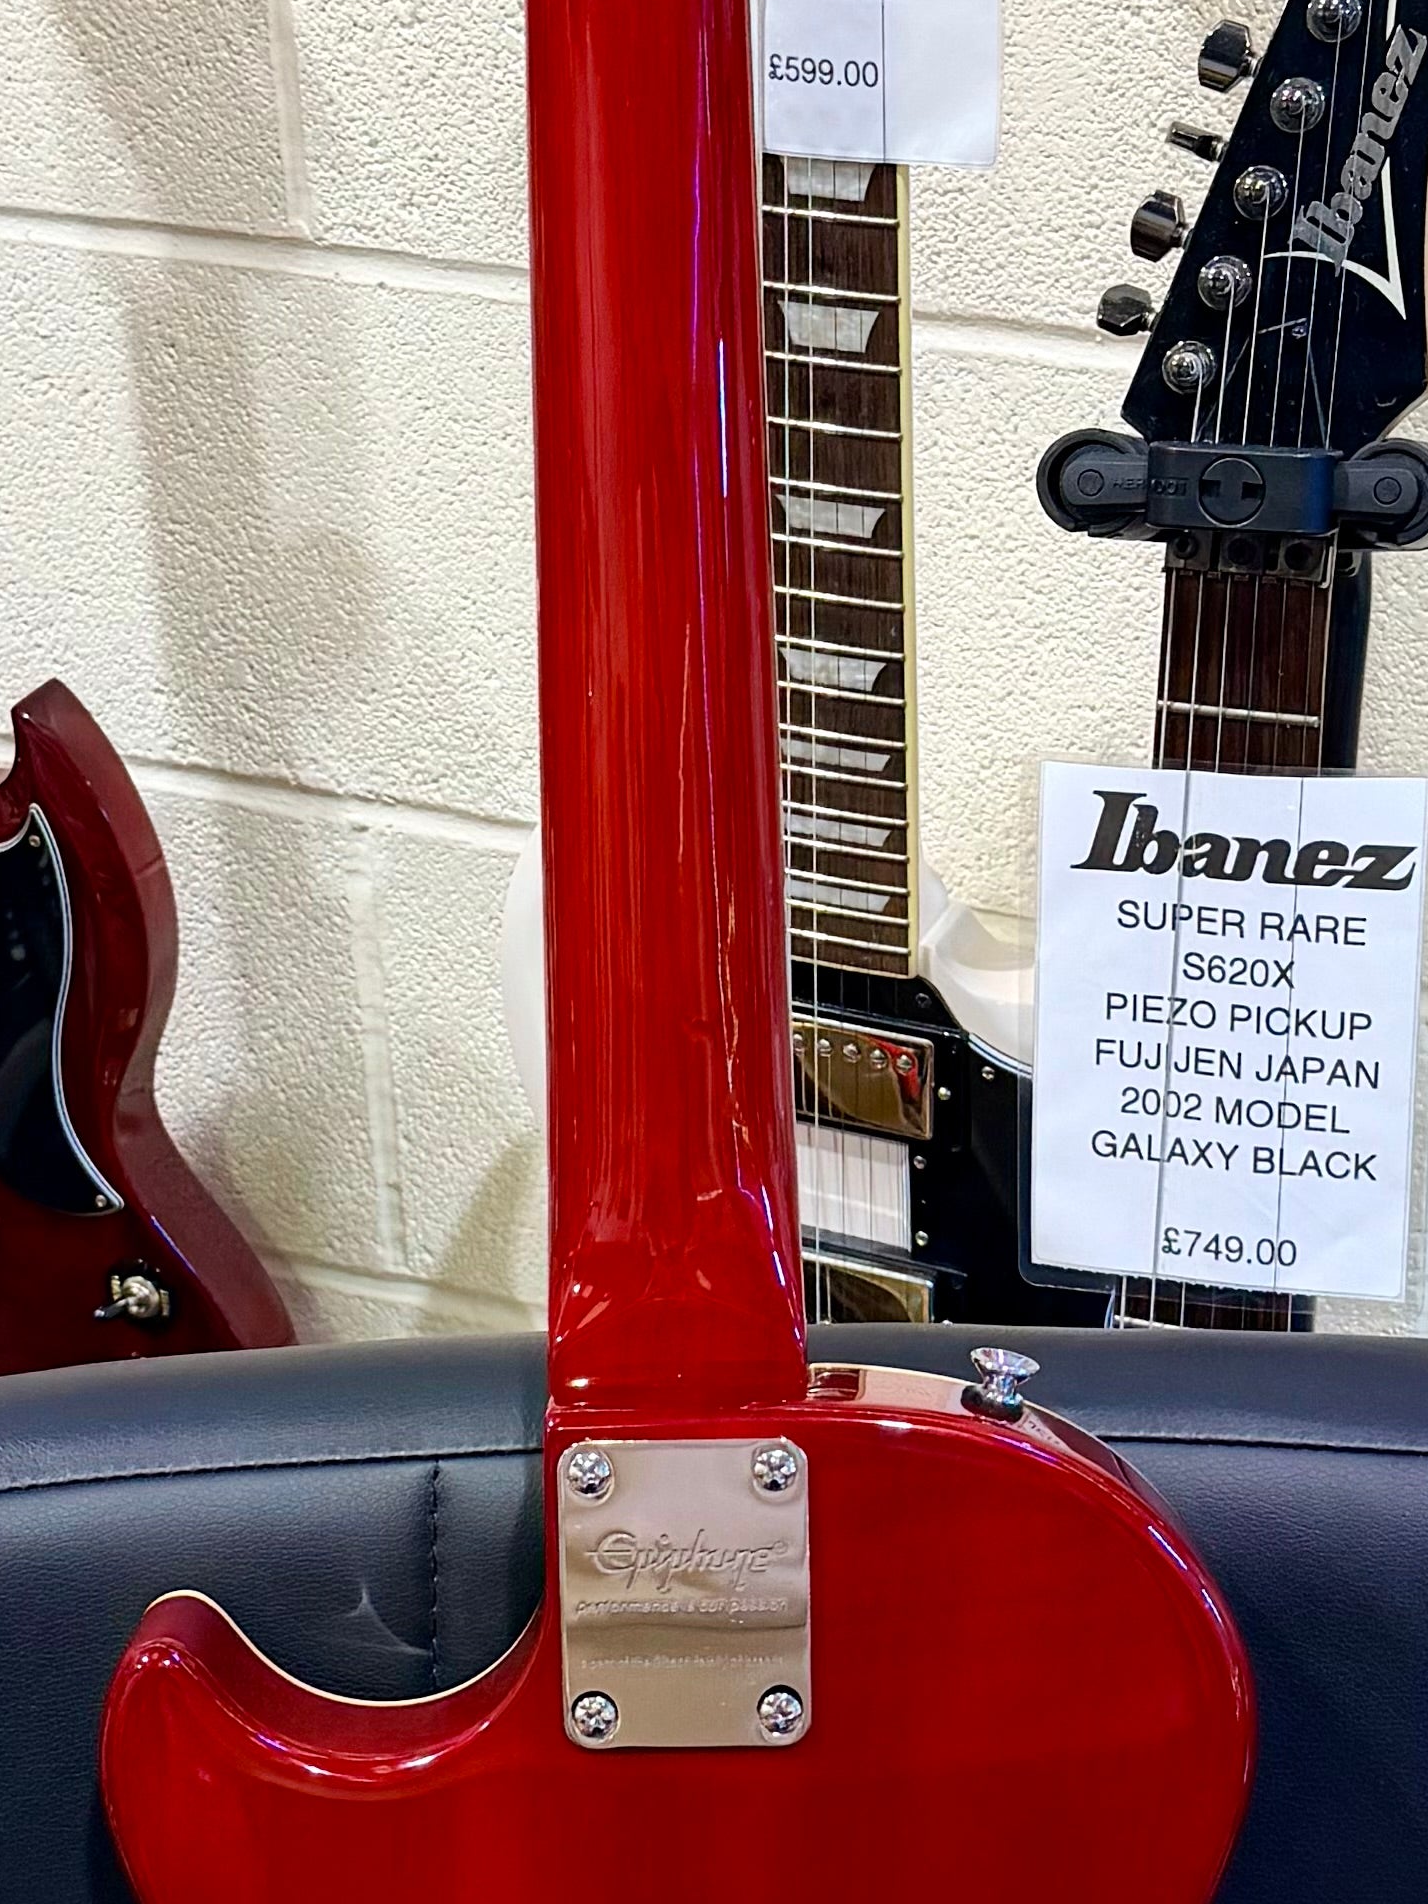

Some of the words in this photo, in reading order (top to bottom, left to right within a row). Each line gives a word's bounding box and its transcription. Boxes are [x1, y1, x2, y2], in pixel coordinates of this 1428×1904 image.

[767, 54, 879, 88] £599.00
[1286, 24, 1428, 278] Ibanez
[1070, 789, 1419, 892] Ibanez
[1117, 899, 1245, 939] SUPER
[1259, 912, 1367, 946] RARE
[1182, 952, 1296, 990] S620X
[1105, 992, 1217, 1030] PIEZO
[1229, 1004, 1372, 1042] PICKUP
[1255, 1053, 1380, 1090] JAPAN
[1120, 1086, 1202, 1121] 2002
[1215, 1096, 1351, 1135] MODEL
[1090, 1130, 1240, 1171] GALAXY
[1251, 1146, 1378, 1182] BLACK
[1161, 1226, 1297, 1267] £749.00
[583, 1528, 775, 1593] Epiphone
